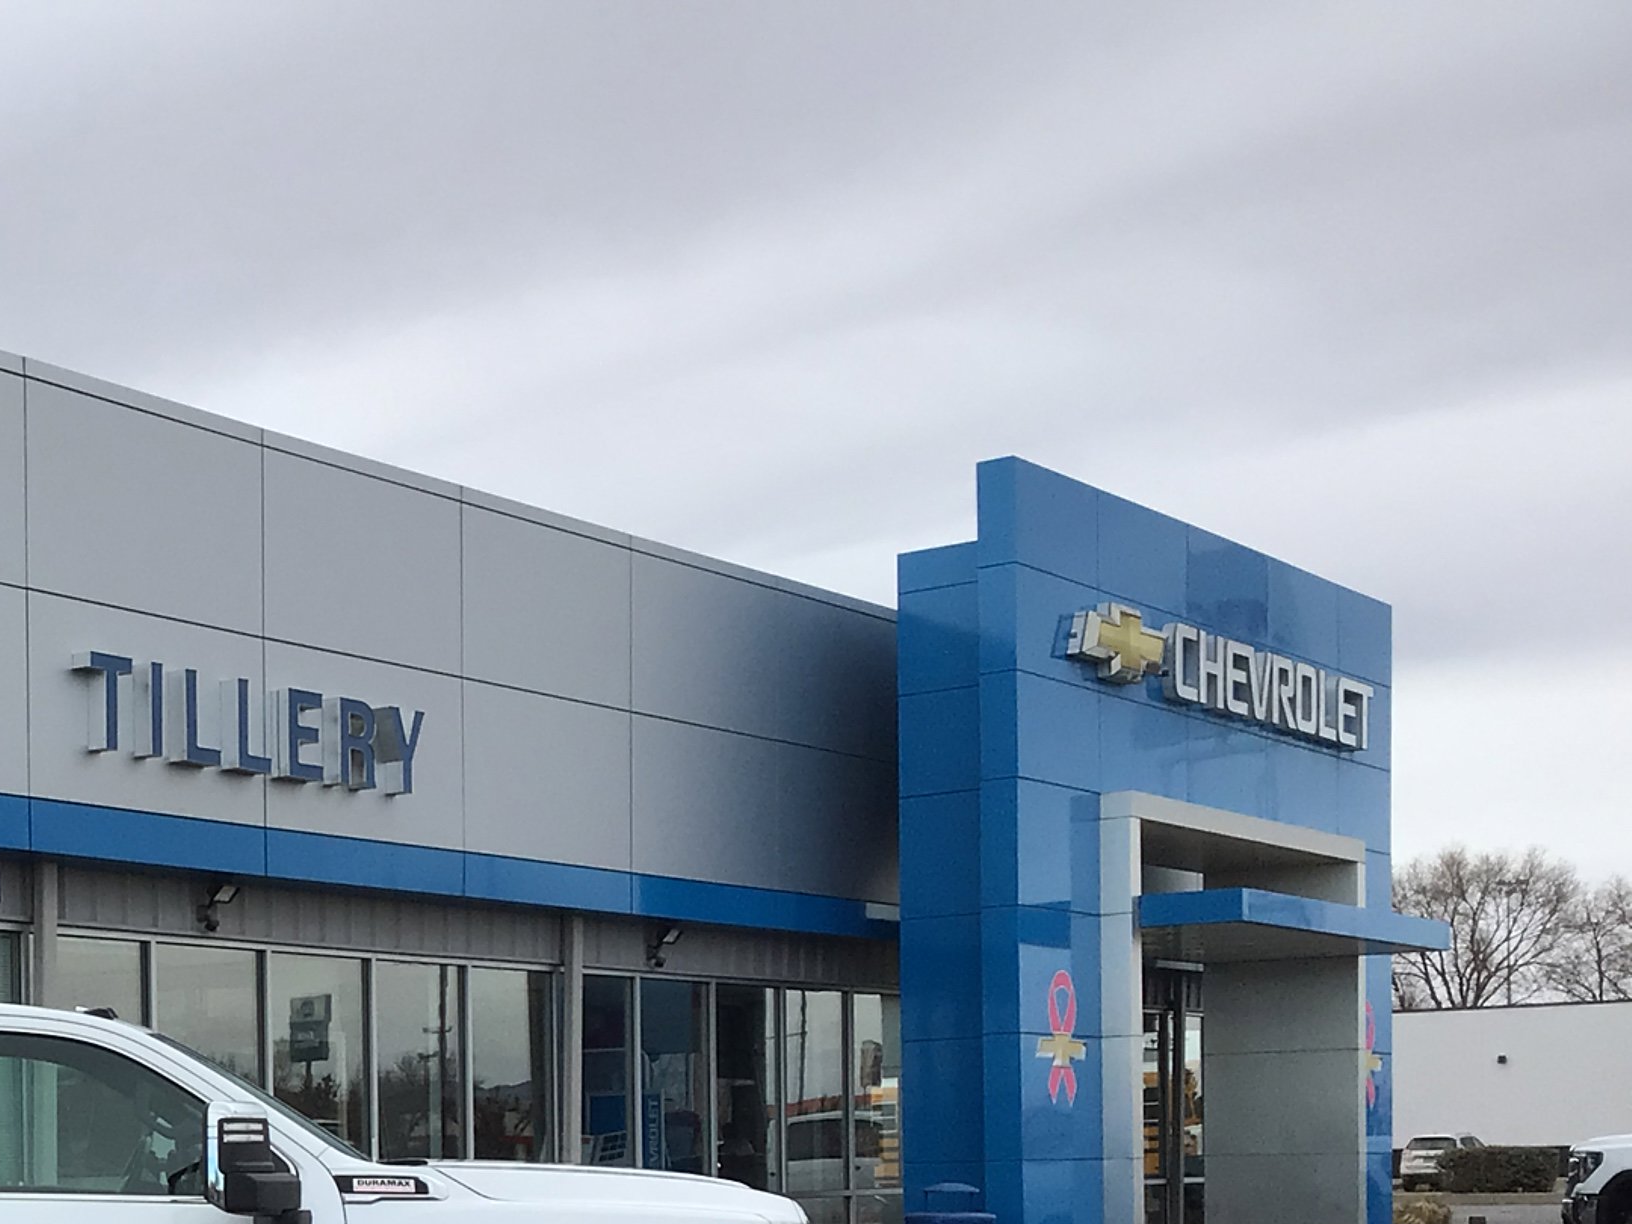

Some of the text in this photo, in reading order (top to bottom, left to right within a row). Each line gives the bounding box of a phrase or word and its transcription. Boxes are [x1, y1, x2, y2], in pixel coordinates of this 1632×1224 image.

[80, 650, 425, 794] TILLERY
[1164, 623, 1374, 750] CHEVROLET
[356, 1179, 411, 1187] DURAMAX
